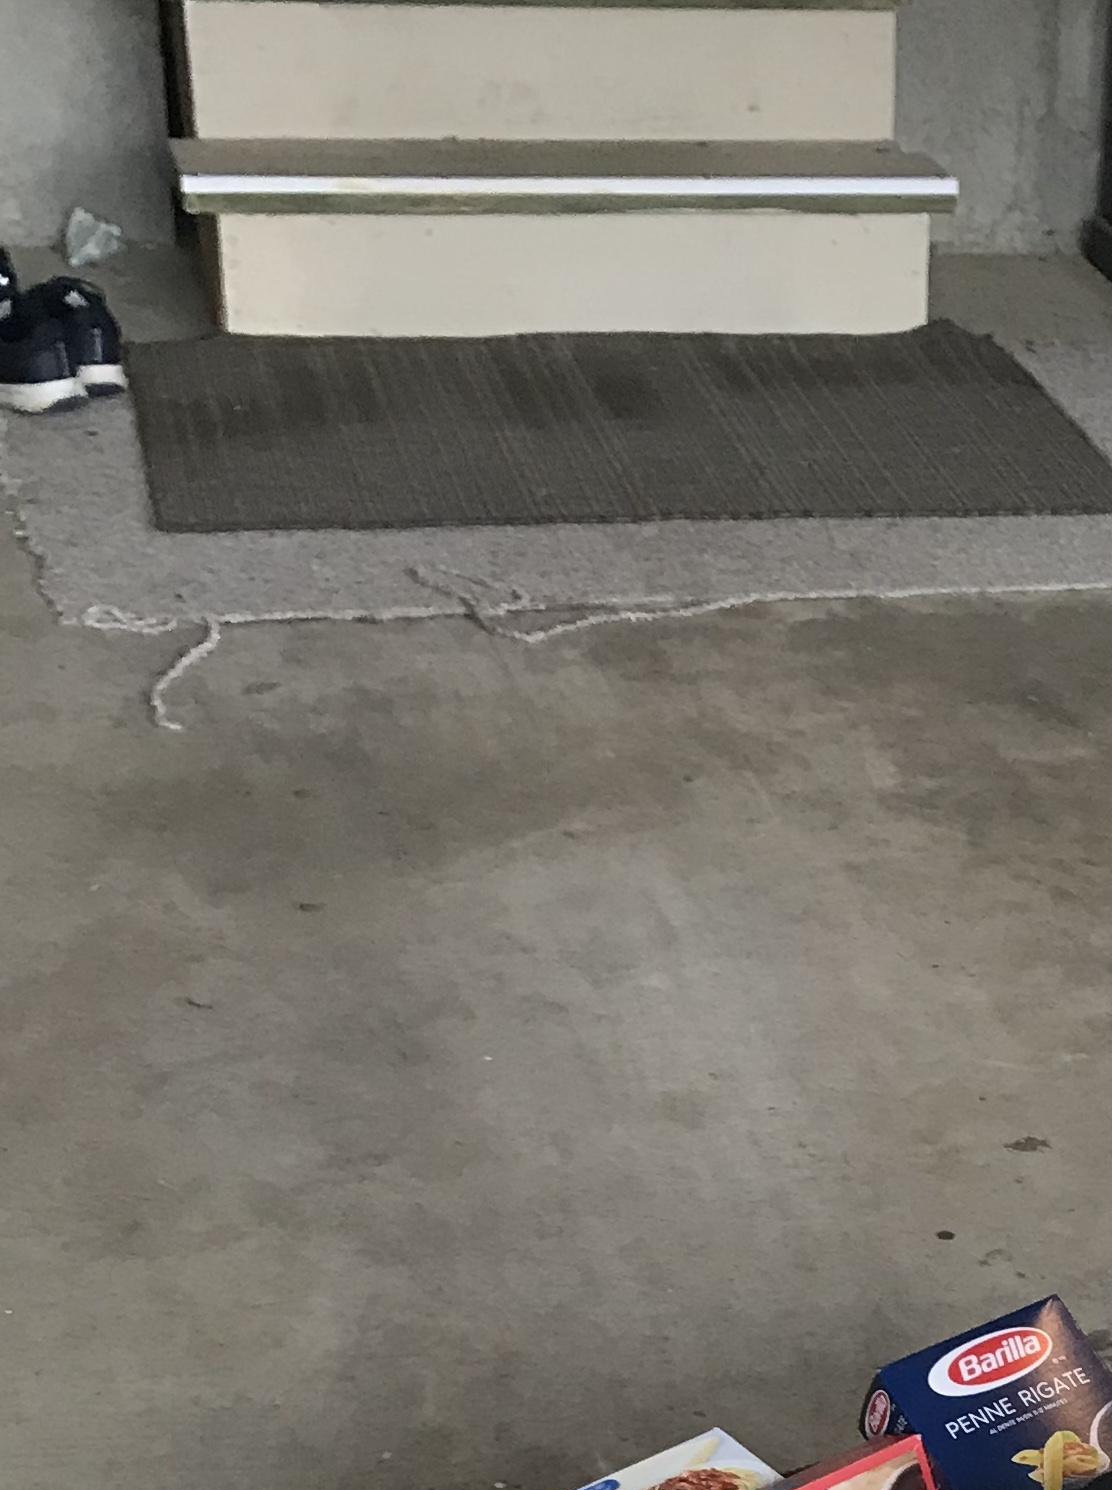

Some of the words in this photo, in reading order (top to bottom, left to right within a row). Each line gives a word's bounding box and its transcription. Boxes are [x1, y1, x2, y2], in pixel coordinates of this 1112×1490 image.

[958, 1331, 1042, 1382] Barilla
[945, 1396, 1018, 1440] PENNE
[1018, 1367, 1092, 1408] RIGATE
